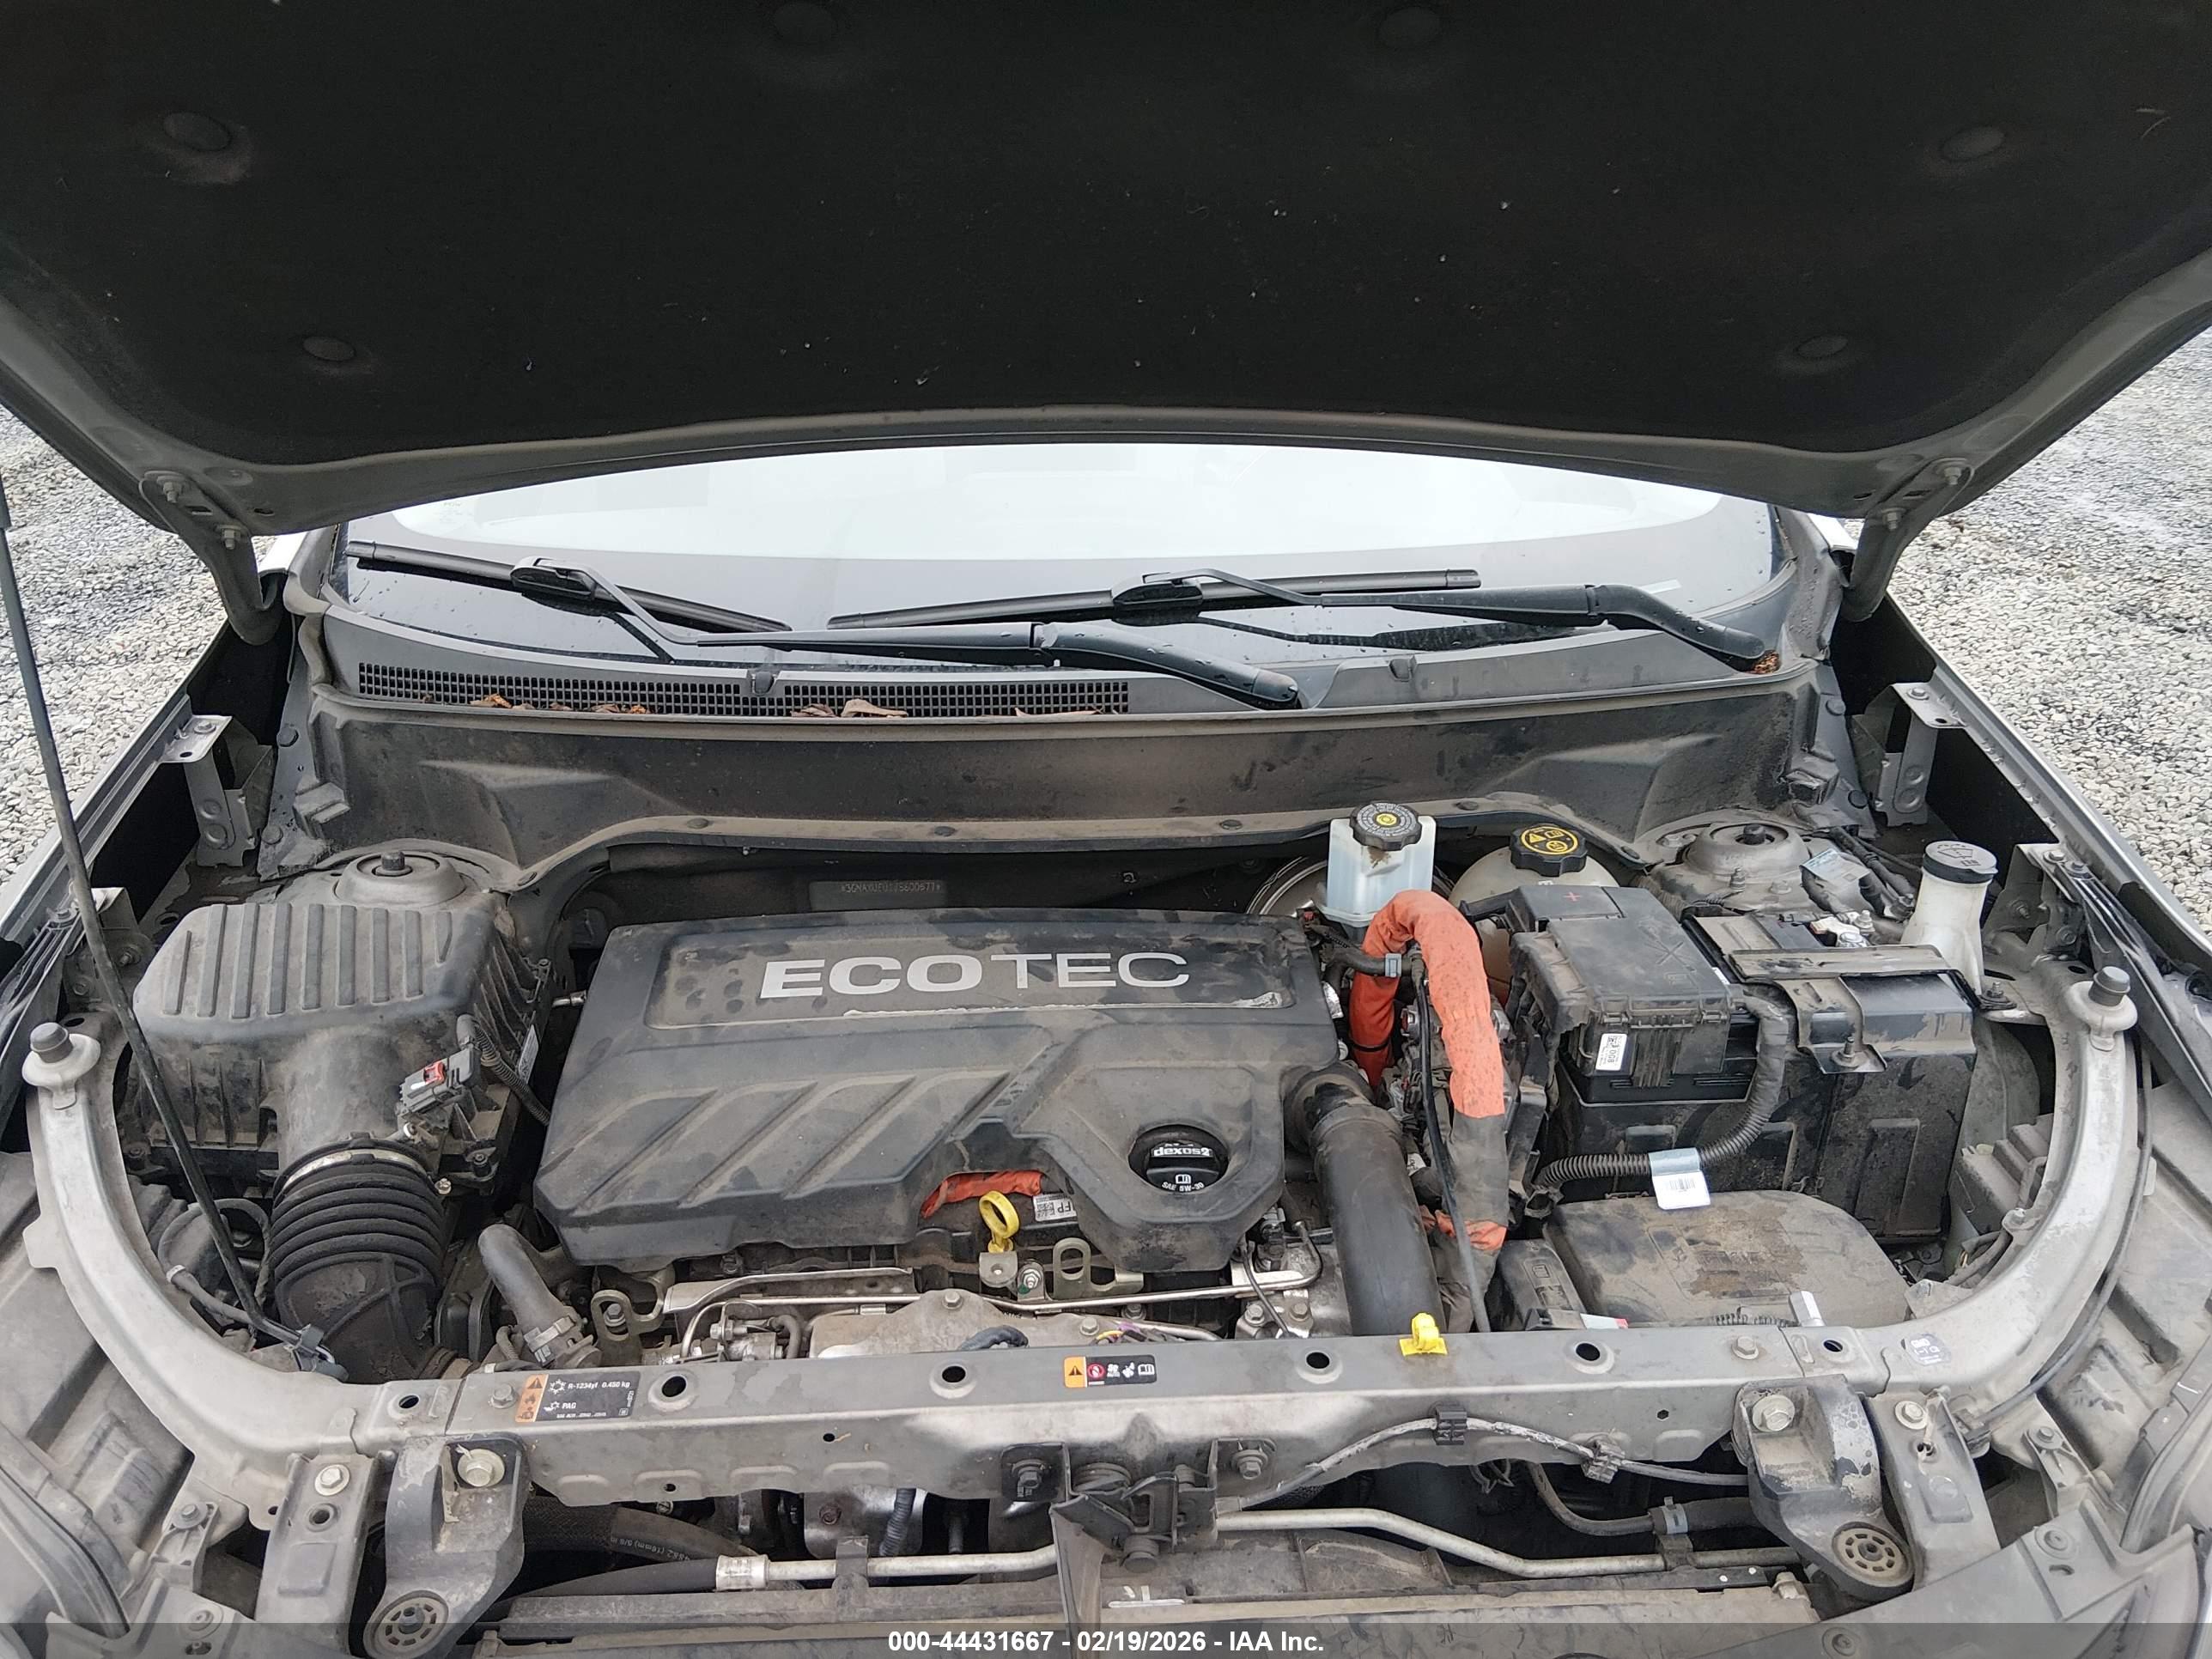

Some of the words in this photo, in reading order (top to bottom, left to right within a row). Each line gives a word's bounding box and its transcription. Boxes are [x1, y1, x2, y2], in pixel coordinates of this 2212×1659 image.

[760, 952, 1189, 999] ECOTEC
[1153, 1146, 1211, 1158] dexos2
[1161, 1182, 1176, 1191] SAE
[1179, 1182, 1205, 1192] 5W-30
[568, 1381, 599, 1390] R-1234yf
[621, 1380, 631, 1389] kg
[562, 1401, 577, 1410] PAG
